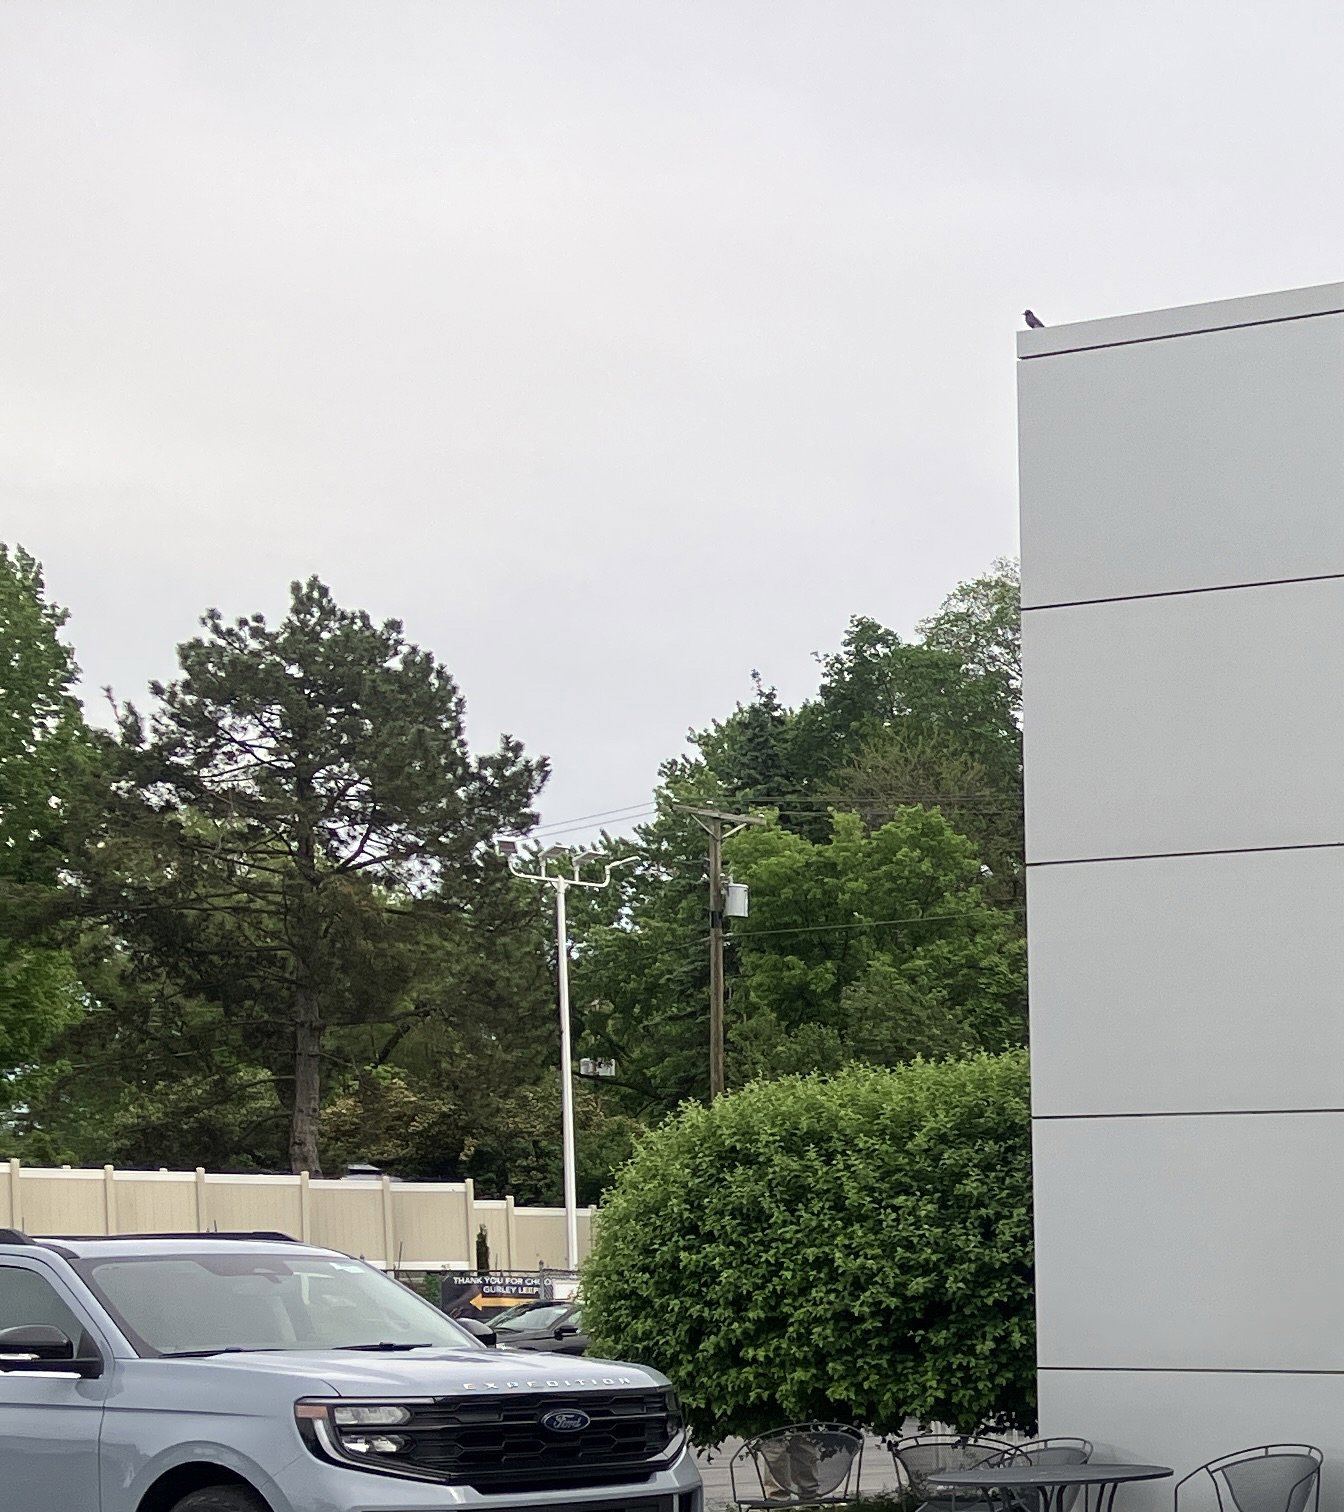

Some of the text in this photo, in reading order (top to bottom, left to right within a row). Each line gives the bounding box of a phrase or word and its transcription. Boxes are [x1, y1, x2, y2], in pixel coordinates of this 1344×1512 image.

[453, 1276, 483, 1285] THANK
[484, 1276, 504, 1285] YOU
[505, 1277, 523, 1285] FOR
[482, 1285, 517, 1294] GURLEY
[462, 1376, 631, 1391] EXPEDITION
[553, 1414, 583, 1430] Ford
